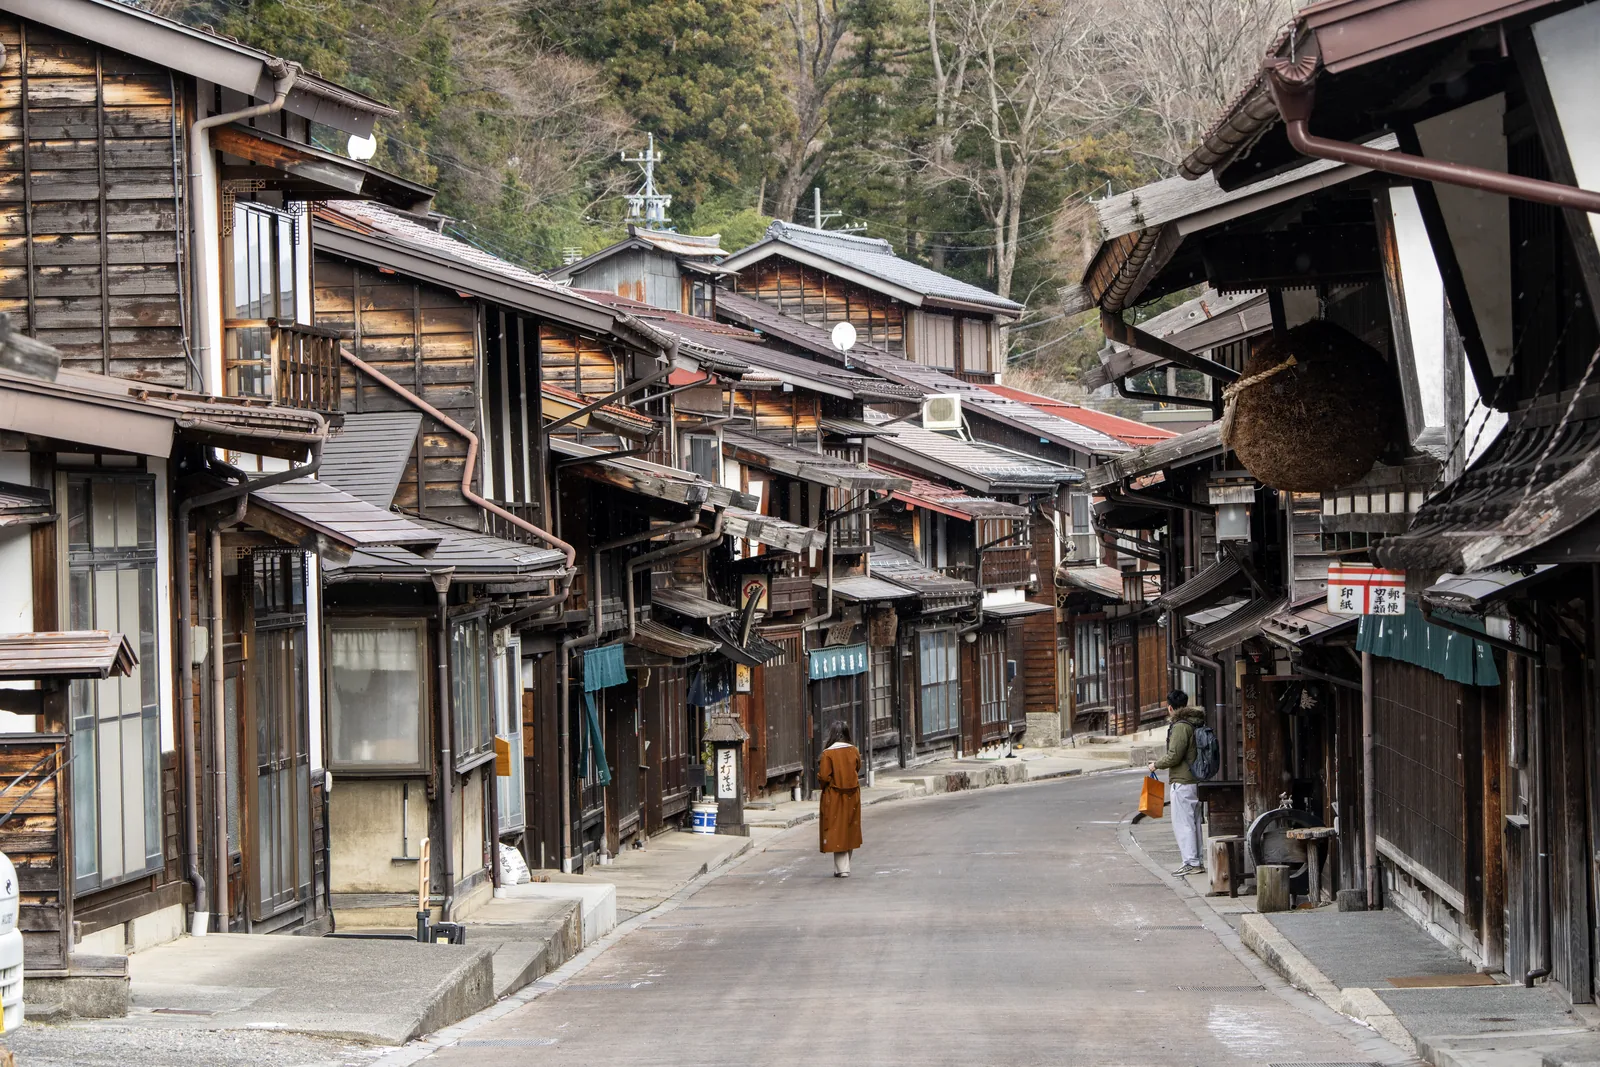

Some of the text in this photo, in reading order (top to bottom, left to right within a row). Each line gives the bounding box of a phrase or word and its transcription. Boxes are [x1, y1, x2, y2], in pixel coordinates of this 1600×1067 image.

[1340, 587, 1353, 610] 印紙
[1373, 588, 1386, 613] 切手類
[1387, 588, 1400, 613] 郵便
[720, 750, 734, 792] 手打そば
